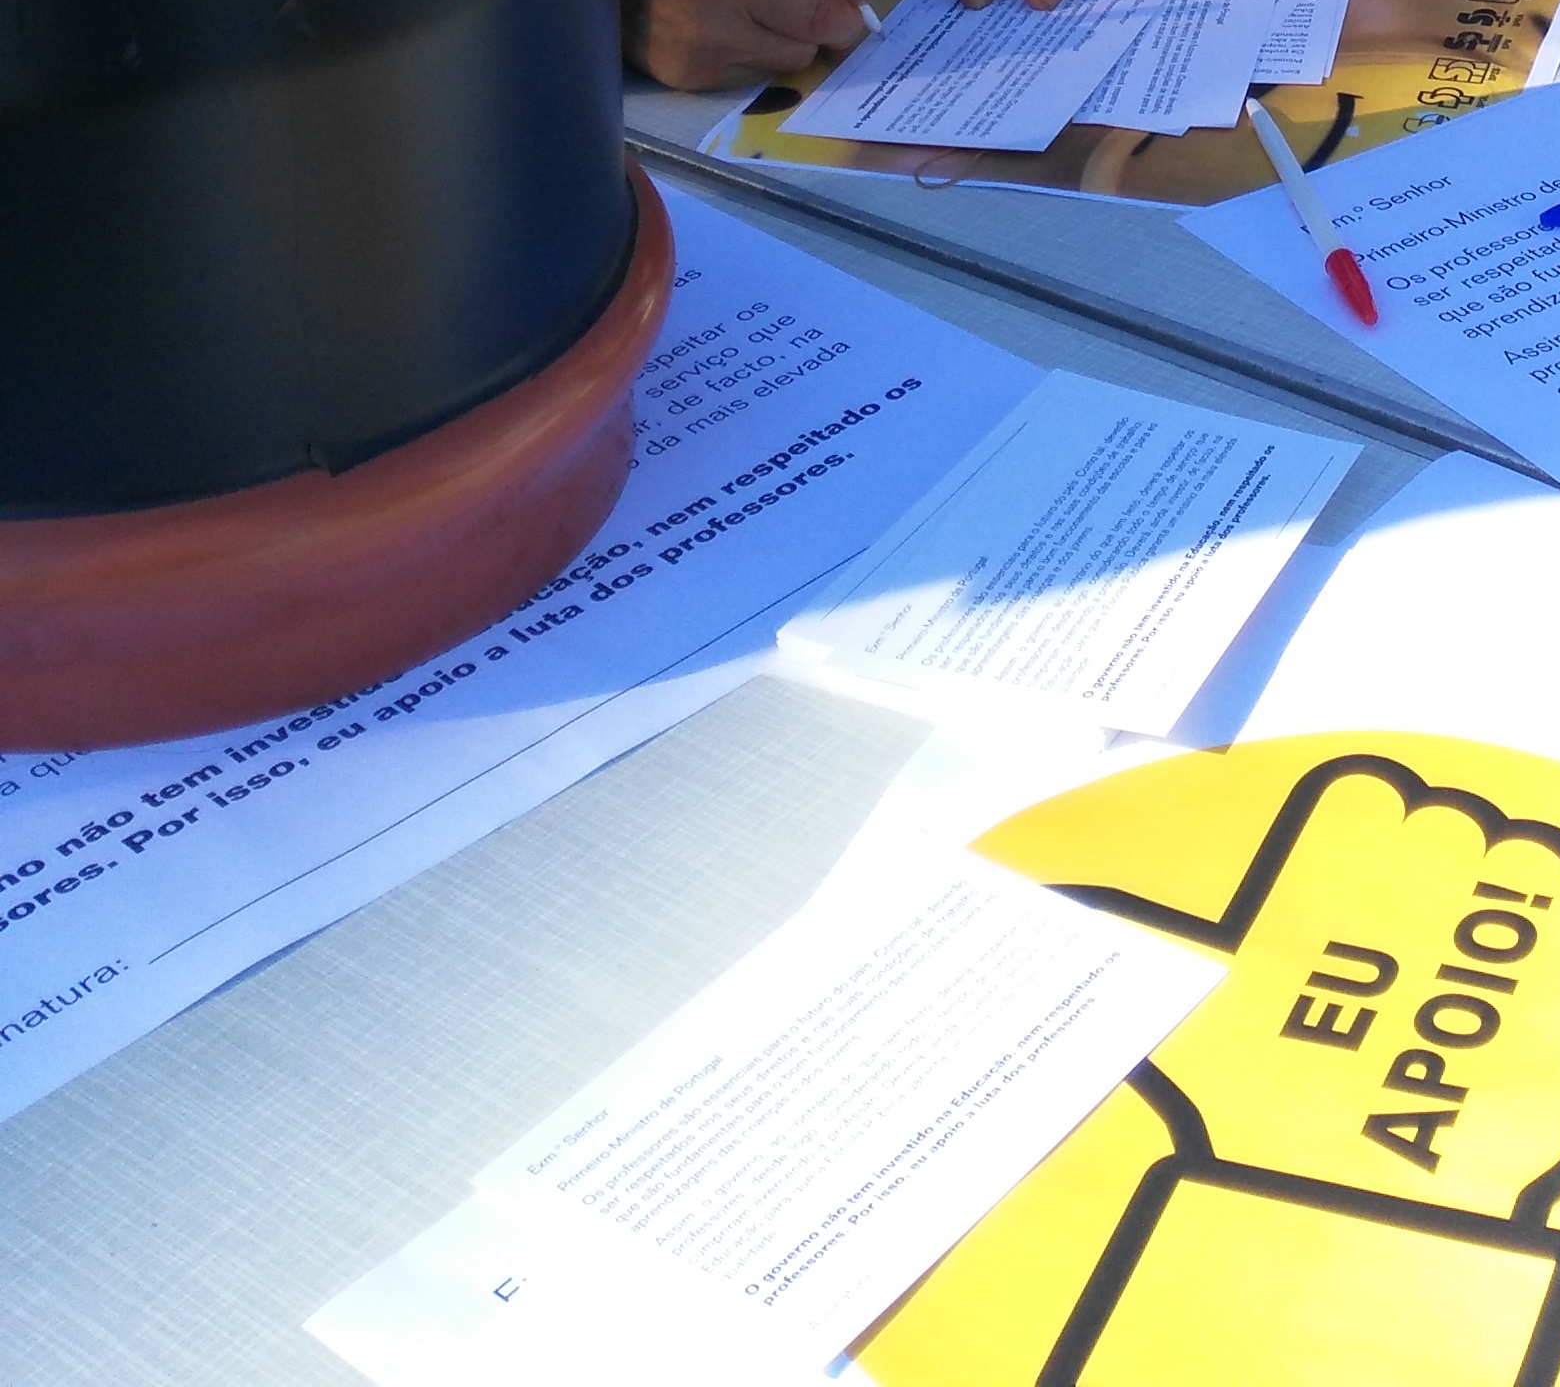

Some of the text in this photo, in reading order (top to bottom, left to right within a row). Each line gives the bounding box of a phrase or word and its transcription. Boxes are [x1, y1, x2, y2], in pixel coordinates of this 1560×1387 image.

[1369, 176, 1452, 211] Senhor
[1386, 274, 1427, 290] Os
[1428, 222, 1553, 280] professore
[1413, 286, 1452, 307] ser
[736, 301, 770, 322] os
[1438, 301, 1485, 323] que
[1488, 281, 1533, 303] são
[645, 315, 797, 399] serviço que
[645, 341, 853, 457] da mais elevada
[667, 328, 825, 416] de facto, na
[646, 378, 922, 536] nem respeitado os
[121, 452, 855, 854] Por isso, eu apoio a luta dos professores.
[55, 764, 223, 857] não tem
[0, 958, 131, 1049] natura:
[1280, 941, 1401, 1052] EU
[1361, 880, 1555, 1176] APOIO!
[847, 1202, 875, 1226] Por
[910, 1155, 928, 1170] eu
[929, 1121, 965, 1154] apoio
[965, 1111, 976, 1119] a
[973, 1087, 1002, 1109] luta
[1002, 1063, 1026, 1084] dos
[1026, 997, 1096, 1063] professores
